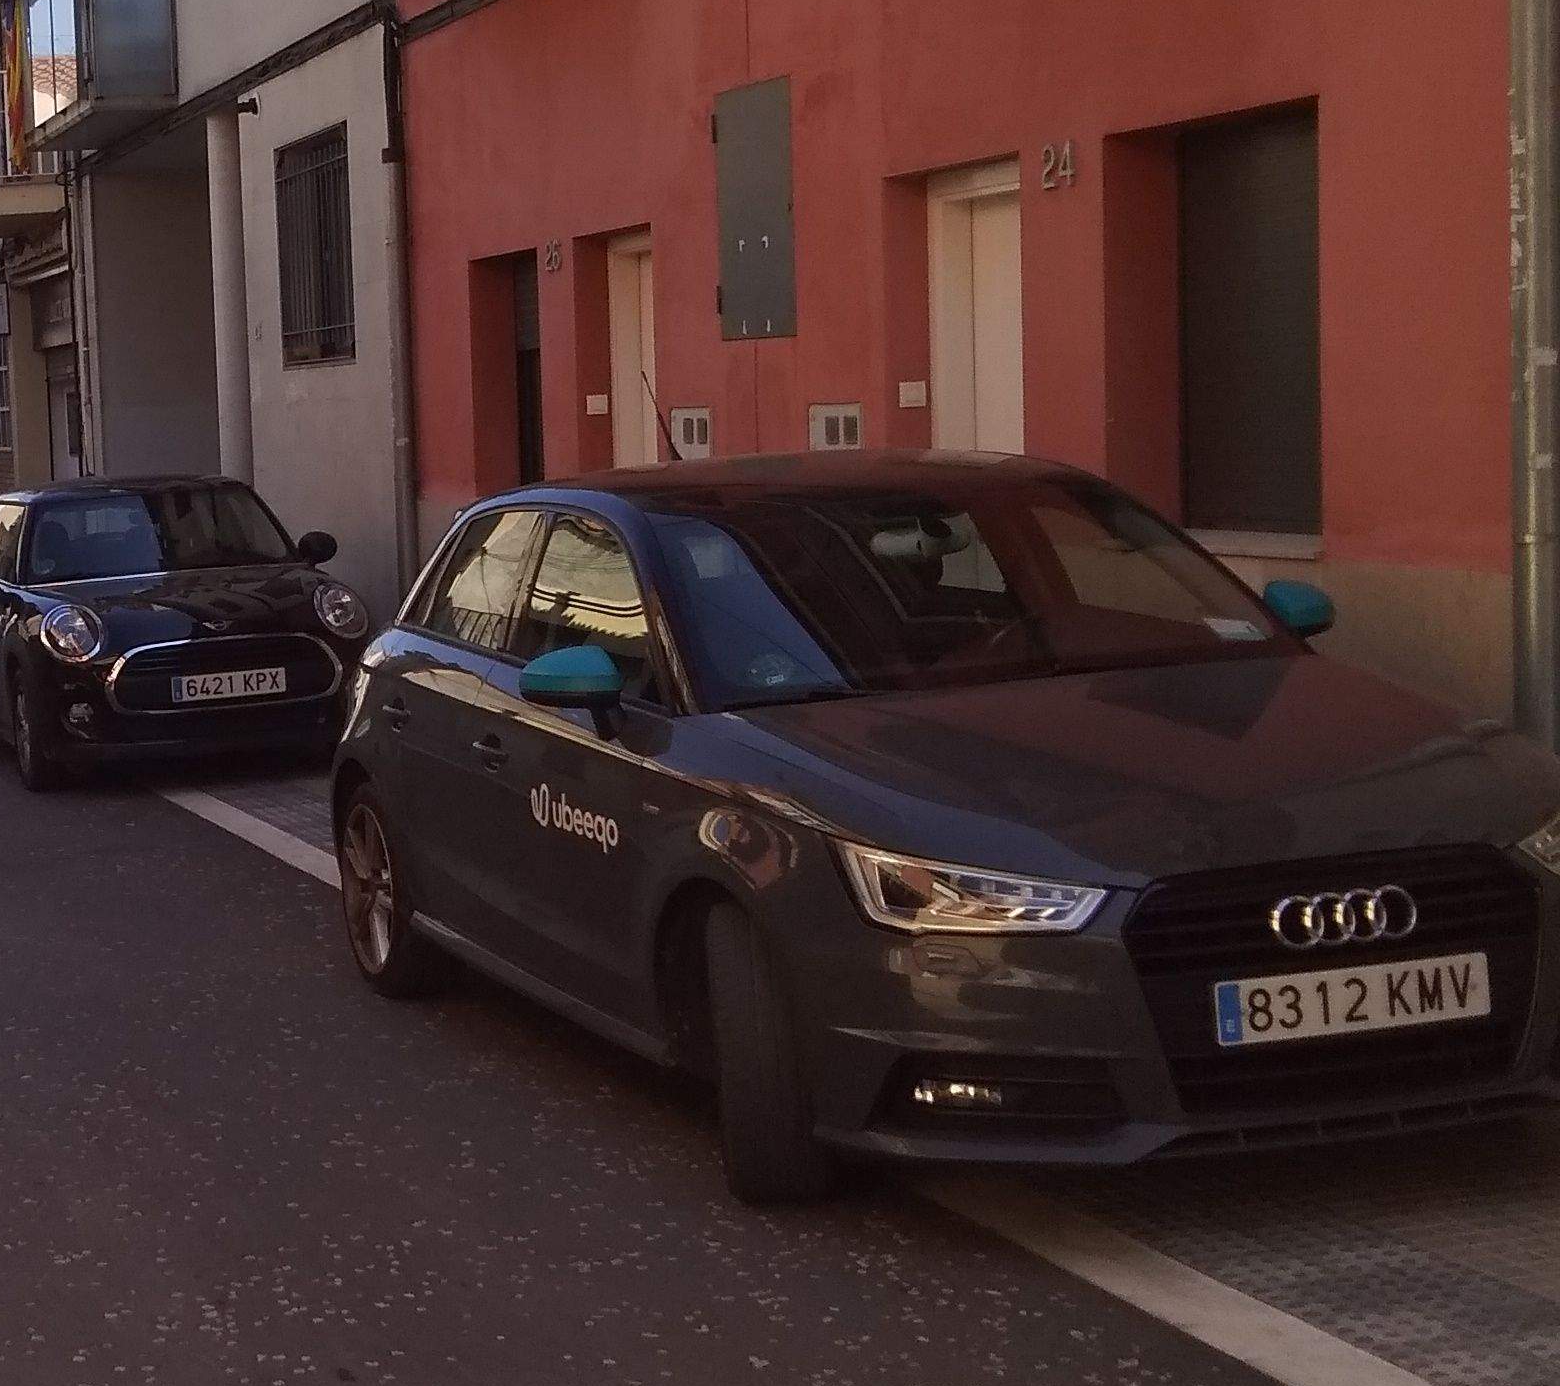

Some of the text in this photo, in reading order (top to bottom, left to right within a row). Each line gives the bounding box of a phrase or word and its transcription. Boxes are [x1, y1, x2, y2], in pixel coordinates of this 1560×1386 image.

[1041, 141, 1074, 189] 24
[186, 671, 280, 697] 6421 KPX
[552, 793, 618, 853] ubeeqo
[1248, 963, 1471, 1032] 8312 KMV
